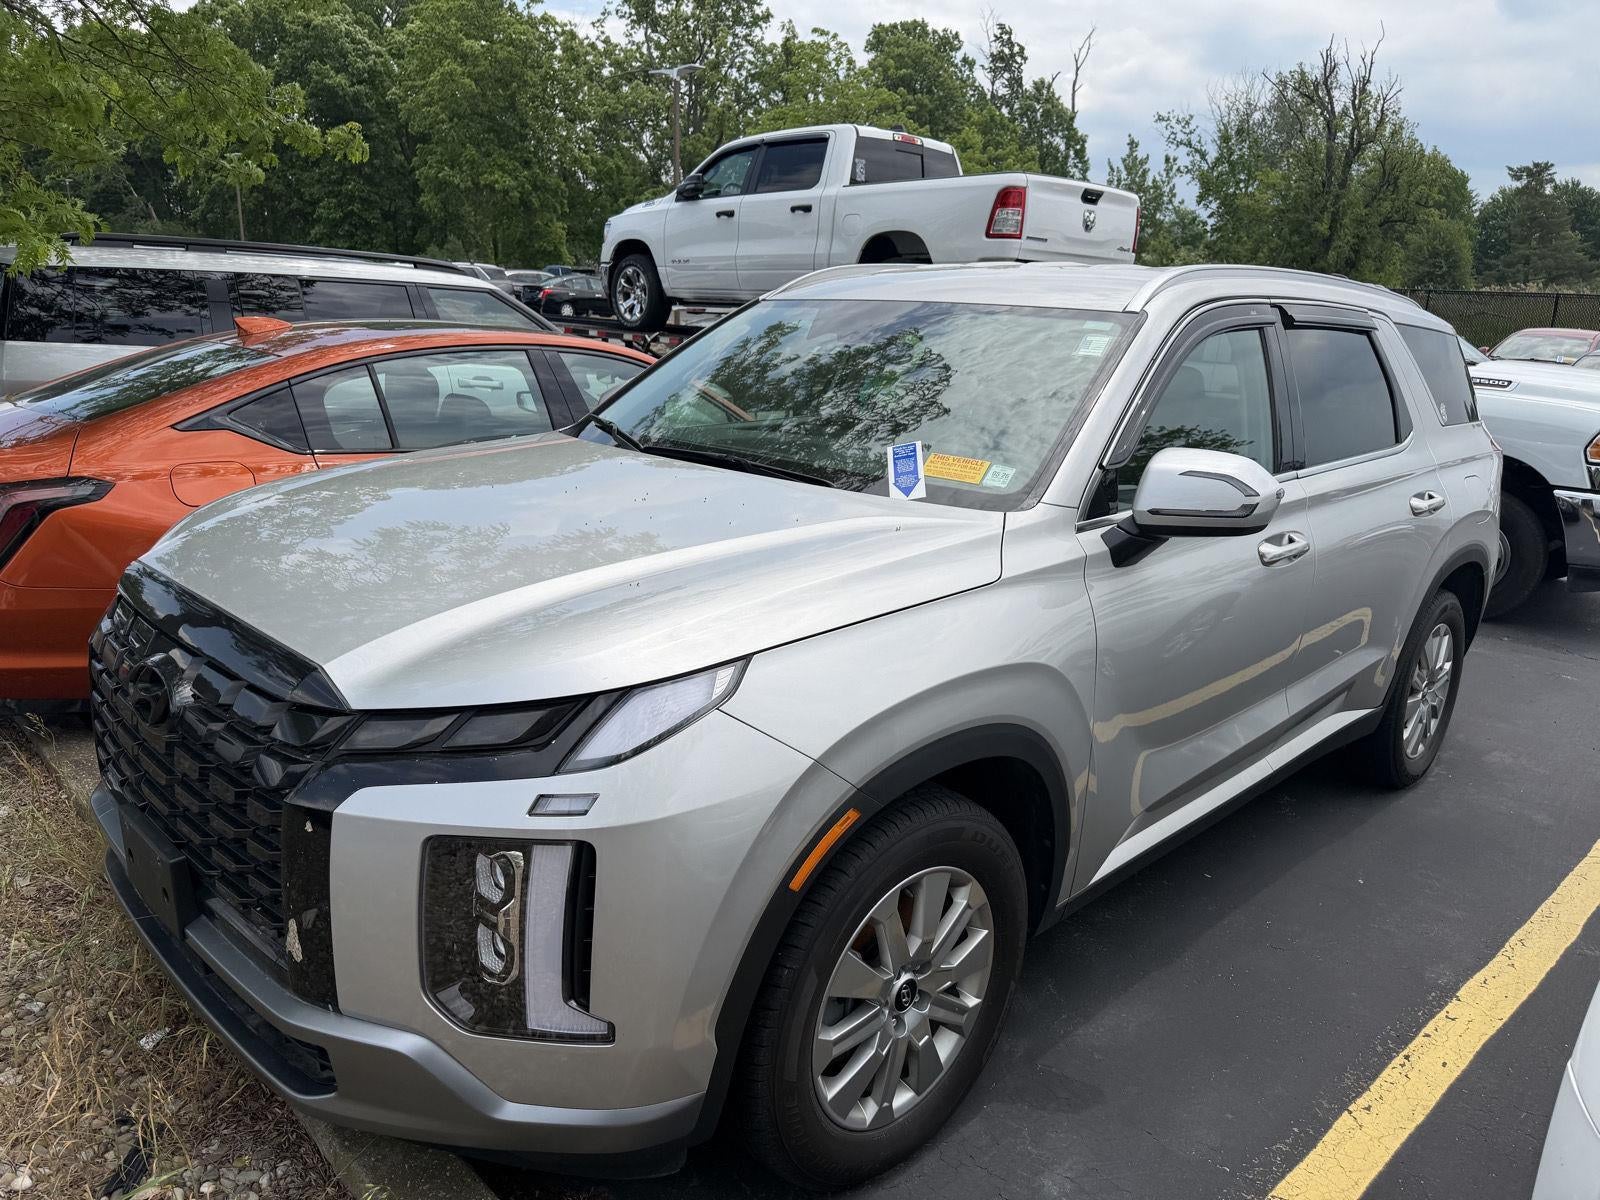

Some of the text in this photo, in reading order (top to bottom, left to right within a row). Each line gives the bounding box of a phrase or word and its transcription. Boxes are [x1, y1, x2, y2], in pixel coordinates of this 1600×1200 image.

[932, 453, 950, 461] THIS
[952, 456, 986, 467] VEHICLE
[940, 460, 958, 468] READY
